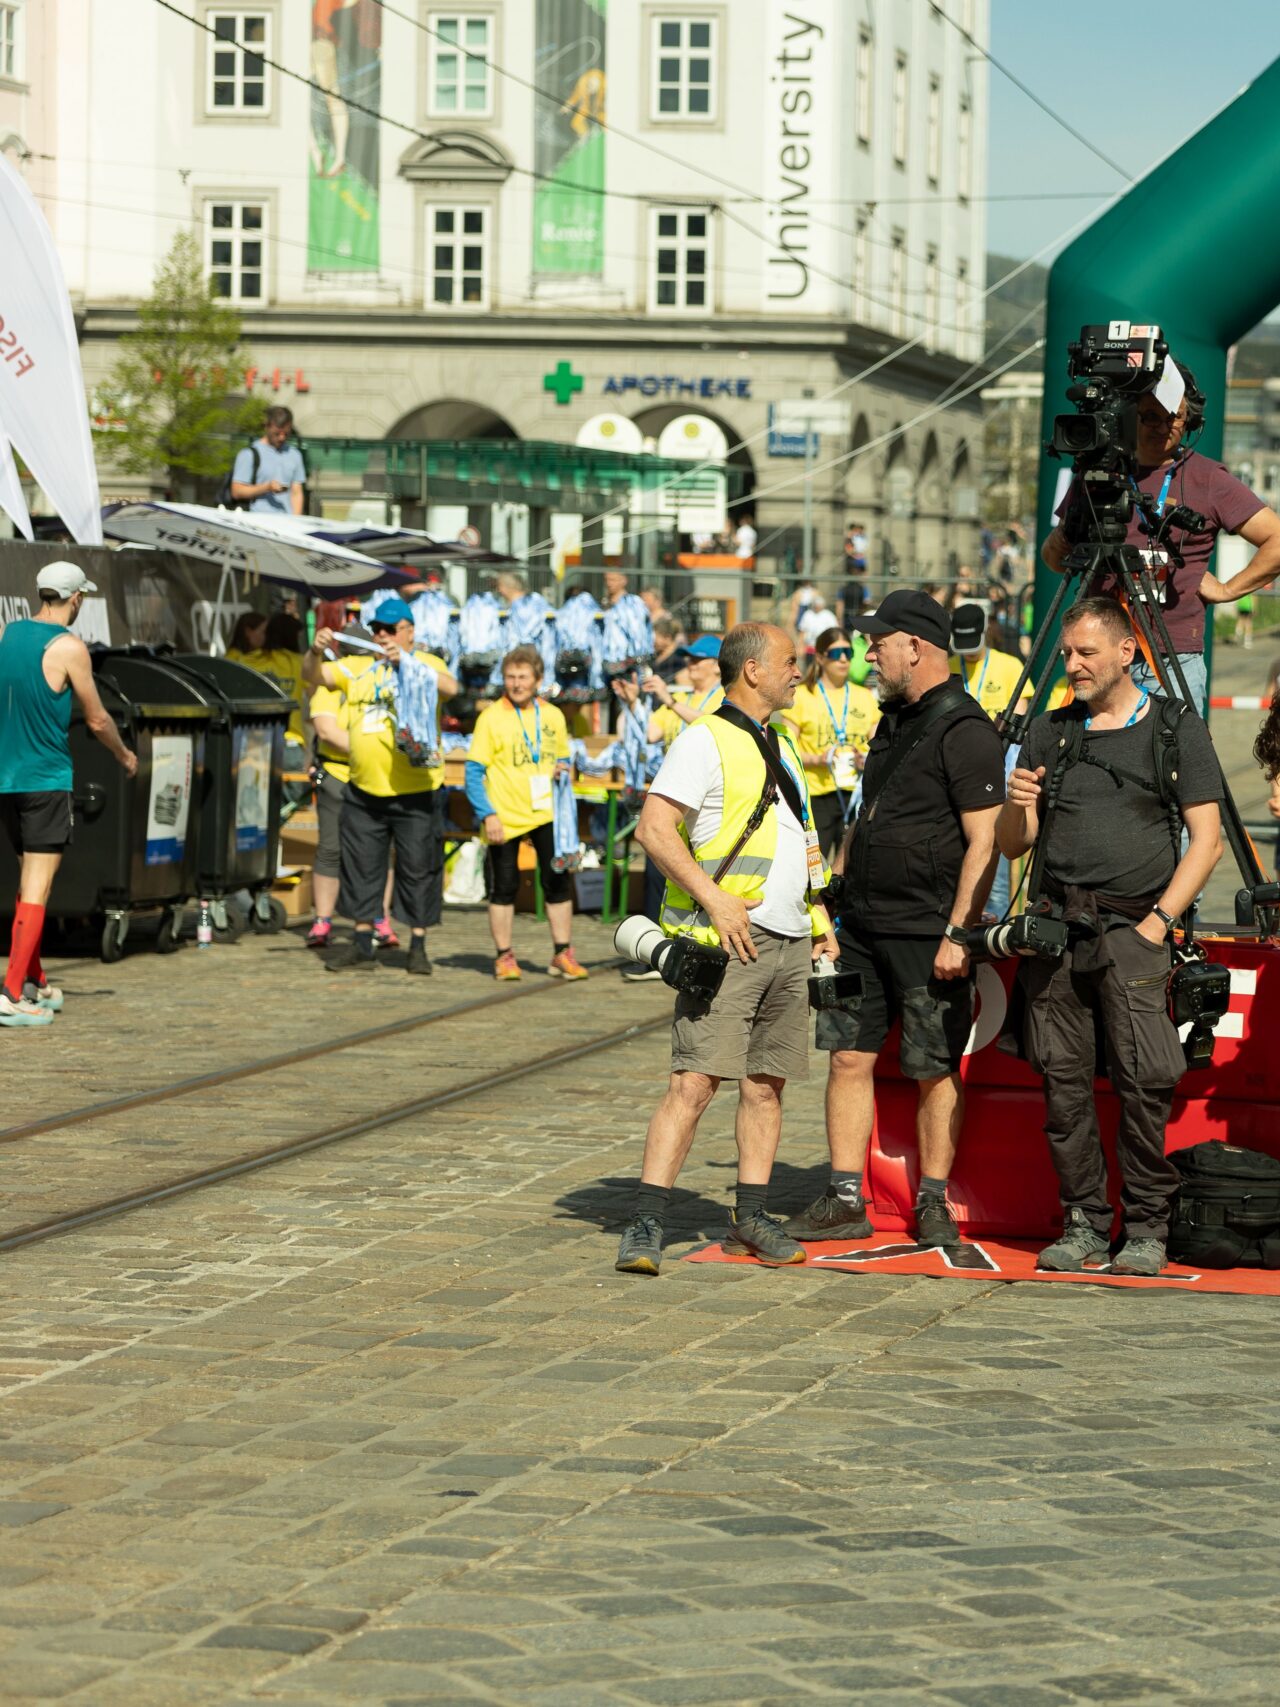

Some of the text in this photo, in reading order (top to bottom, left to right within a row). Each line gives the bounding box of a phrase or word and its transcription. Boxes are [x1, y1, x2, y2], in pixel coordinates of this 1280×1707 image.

[768, 12, 824, 300] University
[1114, 323, 1122, 337] 1
[603, 374, 754, 399] APOTHEKE
